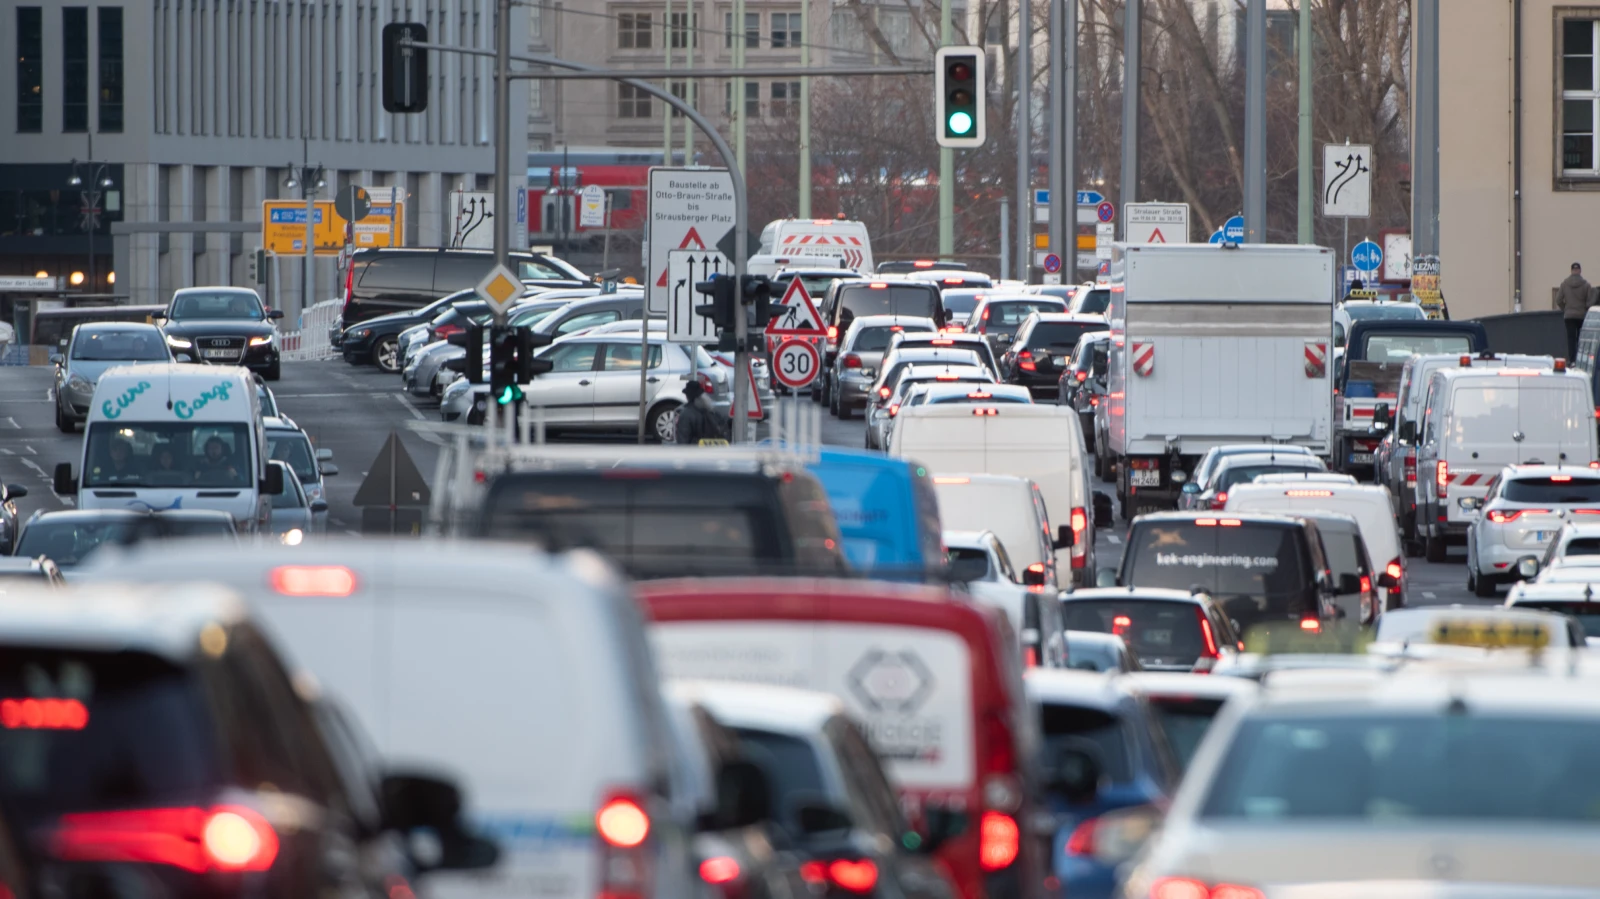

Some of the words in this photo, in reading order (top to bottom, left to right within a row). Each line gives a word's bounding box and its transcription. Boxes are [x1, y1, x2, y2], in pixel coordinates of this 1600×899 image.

[669, 181, 707, 189] Baustelle
[709, 182, 720, 190] ab
[655, 191, 732, 201] Otto-Braun-Straße
[687, 203, 700, 211] bis
[655, 212, 708, 223] Strausberger
[711, 214, 732, 222] Platz
[607, 282, 615, 292] P
[784, 352, 810, 374] 30
[102, 381, 151, 419] Euro
[174, 380, 233, 420] Cargo
[1156, 552, 1279, 569] kek-engineering.com
